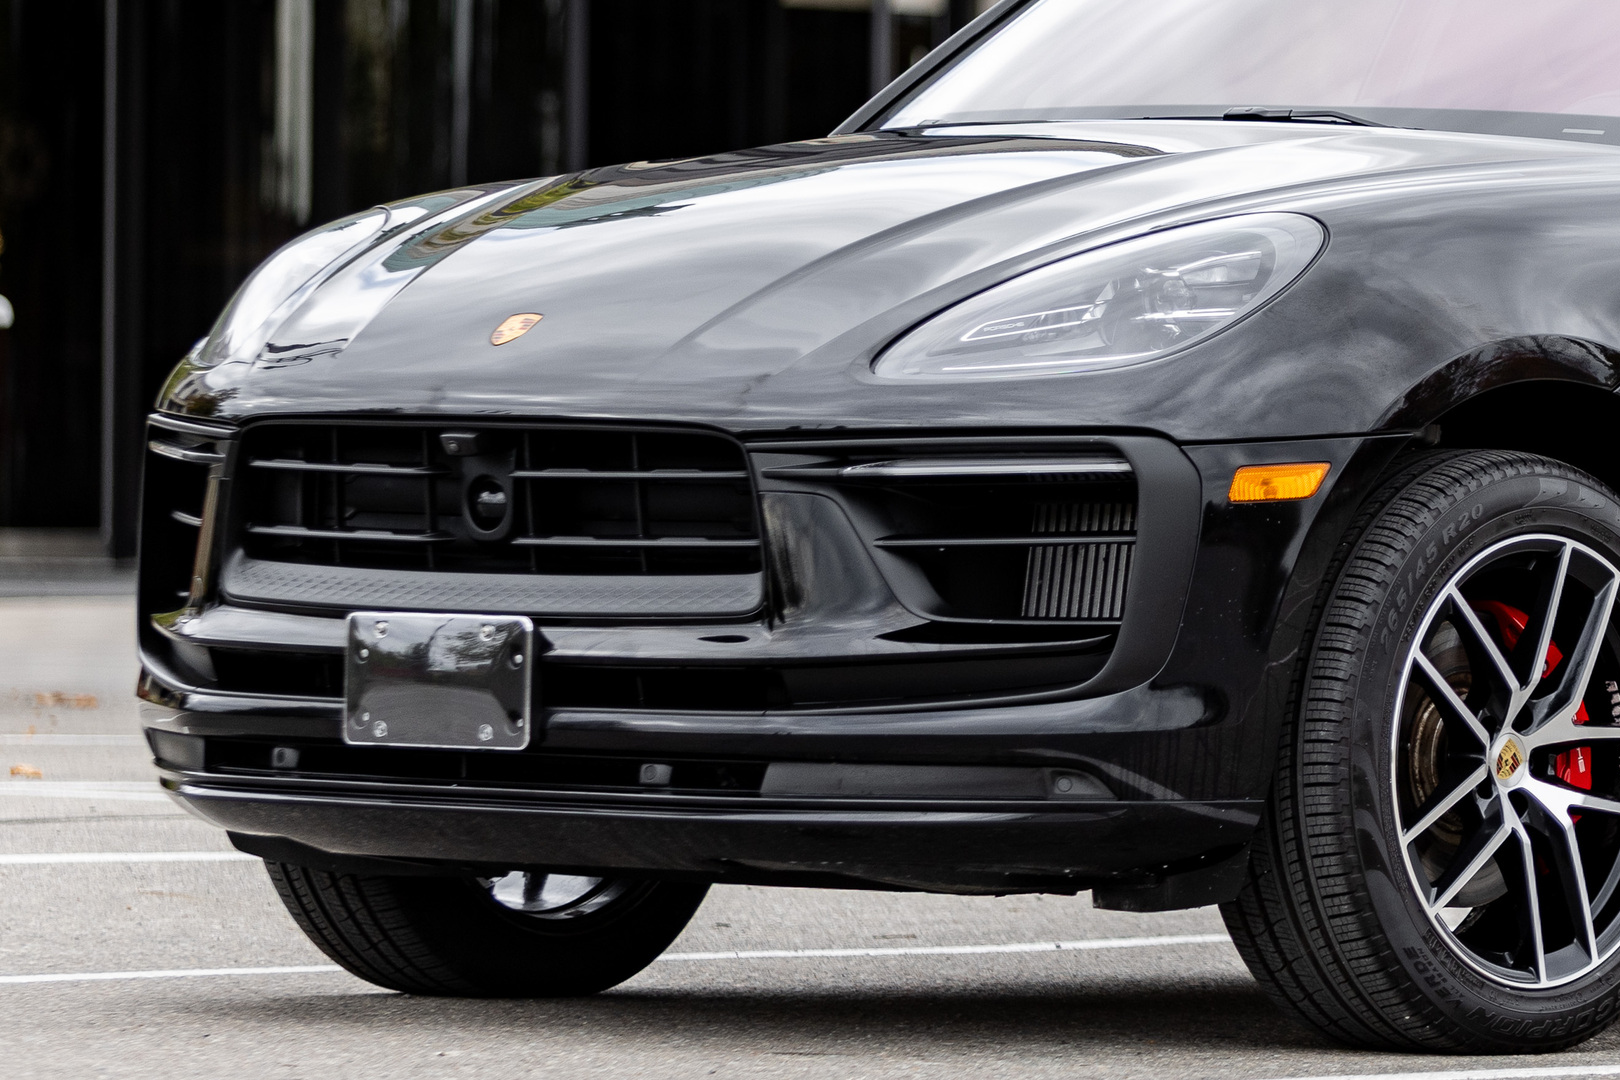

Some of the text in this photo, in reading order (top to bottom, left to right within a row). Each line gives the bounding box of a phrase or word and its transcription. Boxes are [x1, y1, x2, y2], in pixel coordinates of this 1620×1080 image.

[1379, 539, 1439, 655] 265/45
[1441, 502, 1484, 546] R20
[1402, 944, 1463, 1009] VERDE
